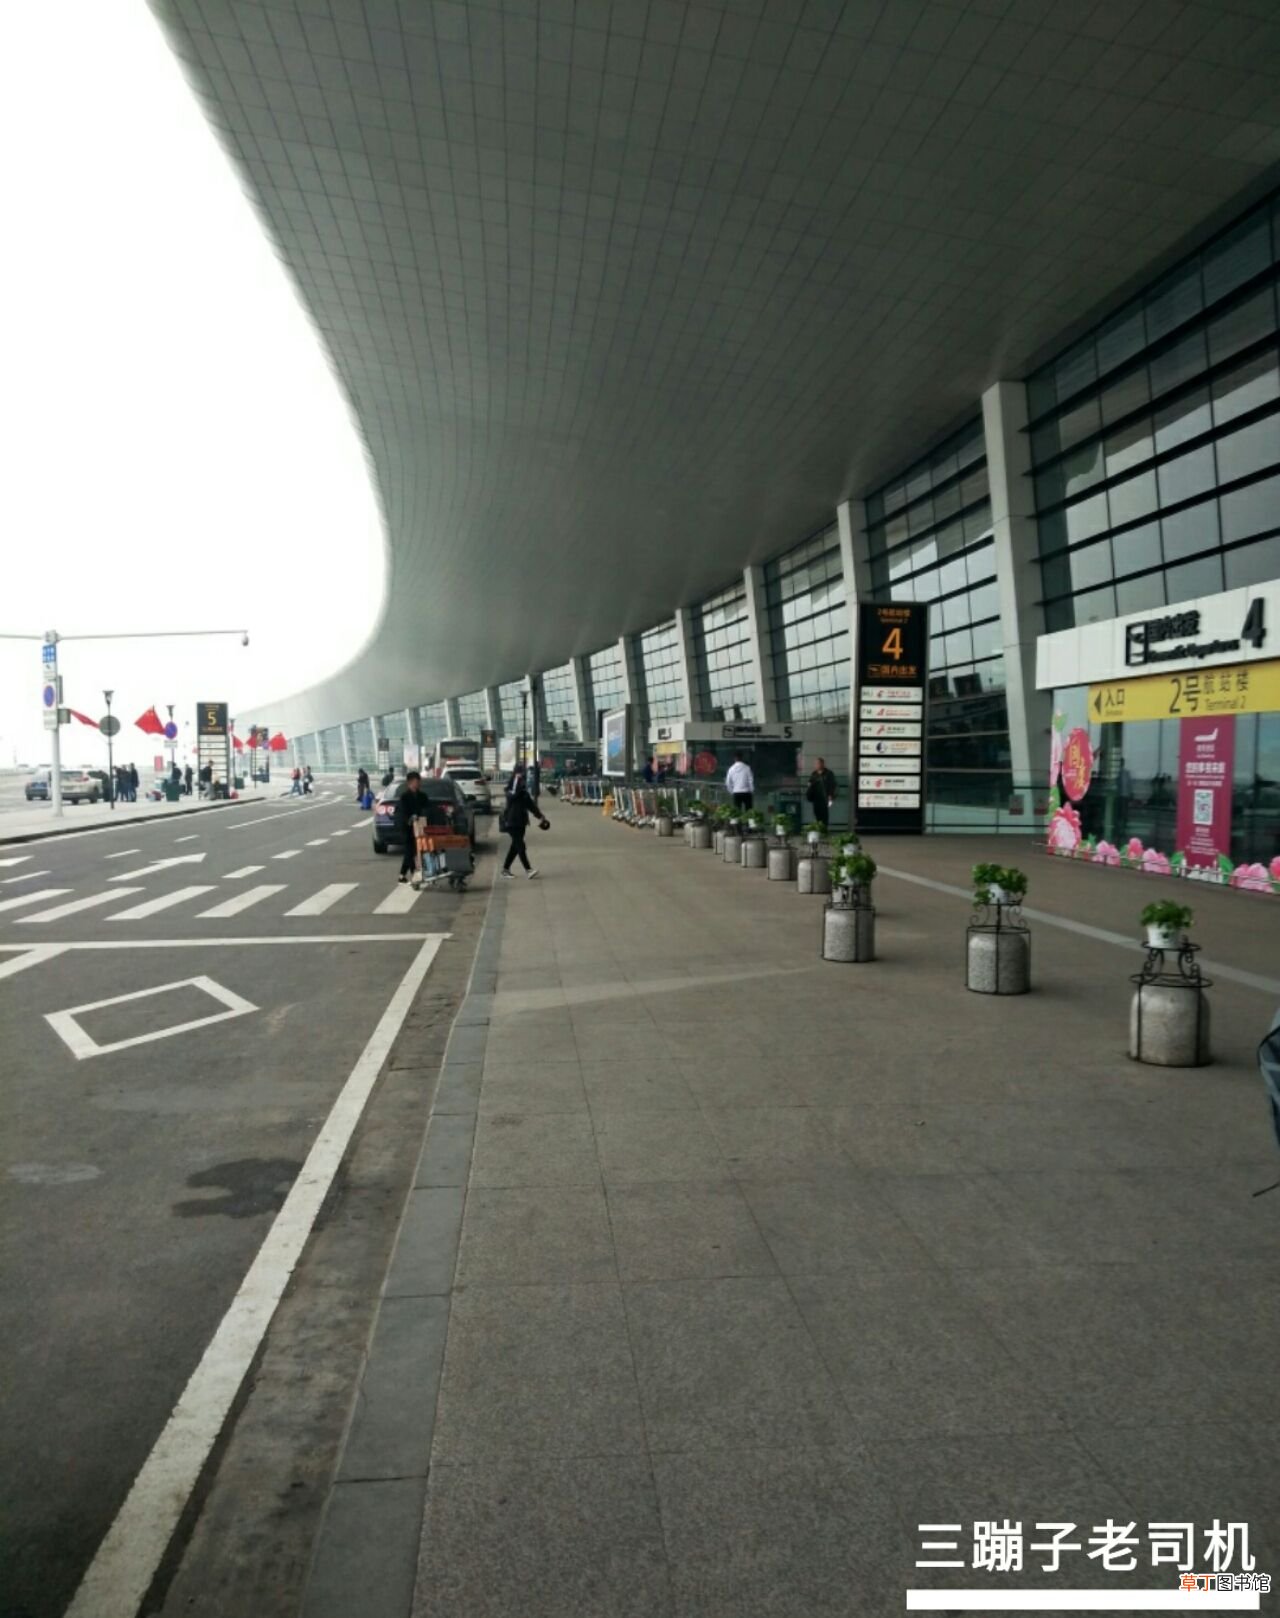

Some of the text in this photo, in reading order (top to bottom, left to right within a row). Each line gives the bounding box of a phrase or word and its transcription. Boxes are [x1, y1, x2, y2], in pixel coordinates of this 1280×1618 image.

[1242, 597, 1267, 648] 4
[882, 628, 903, 660] 4
[1105, 688, 1125, 706] 入口
[1205, 697, 1247, 711] Terminal 2
[208, 712, 216, 725] 5
[784, 726, 792, 739] 5
